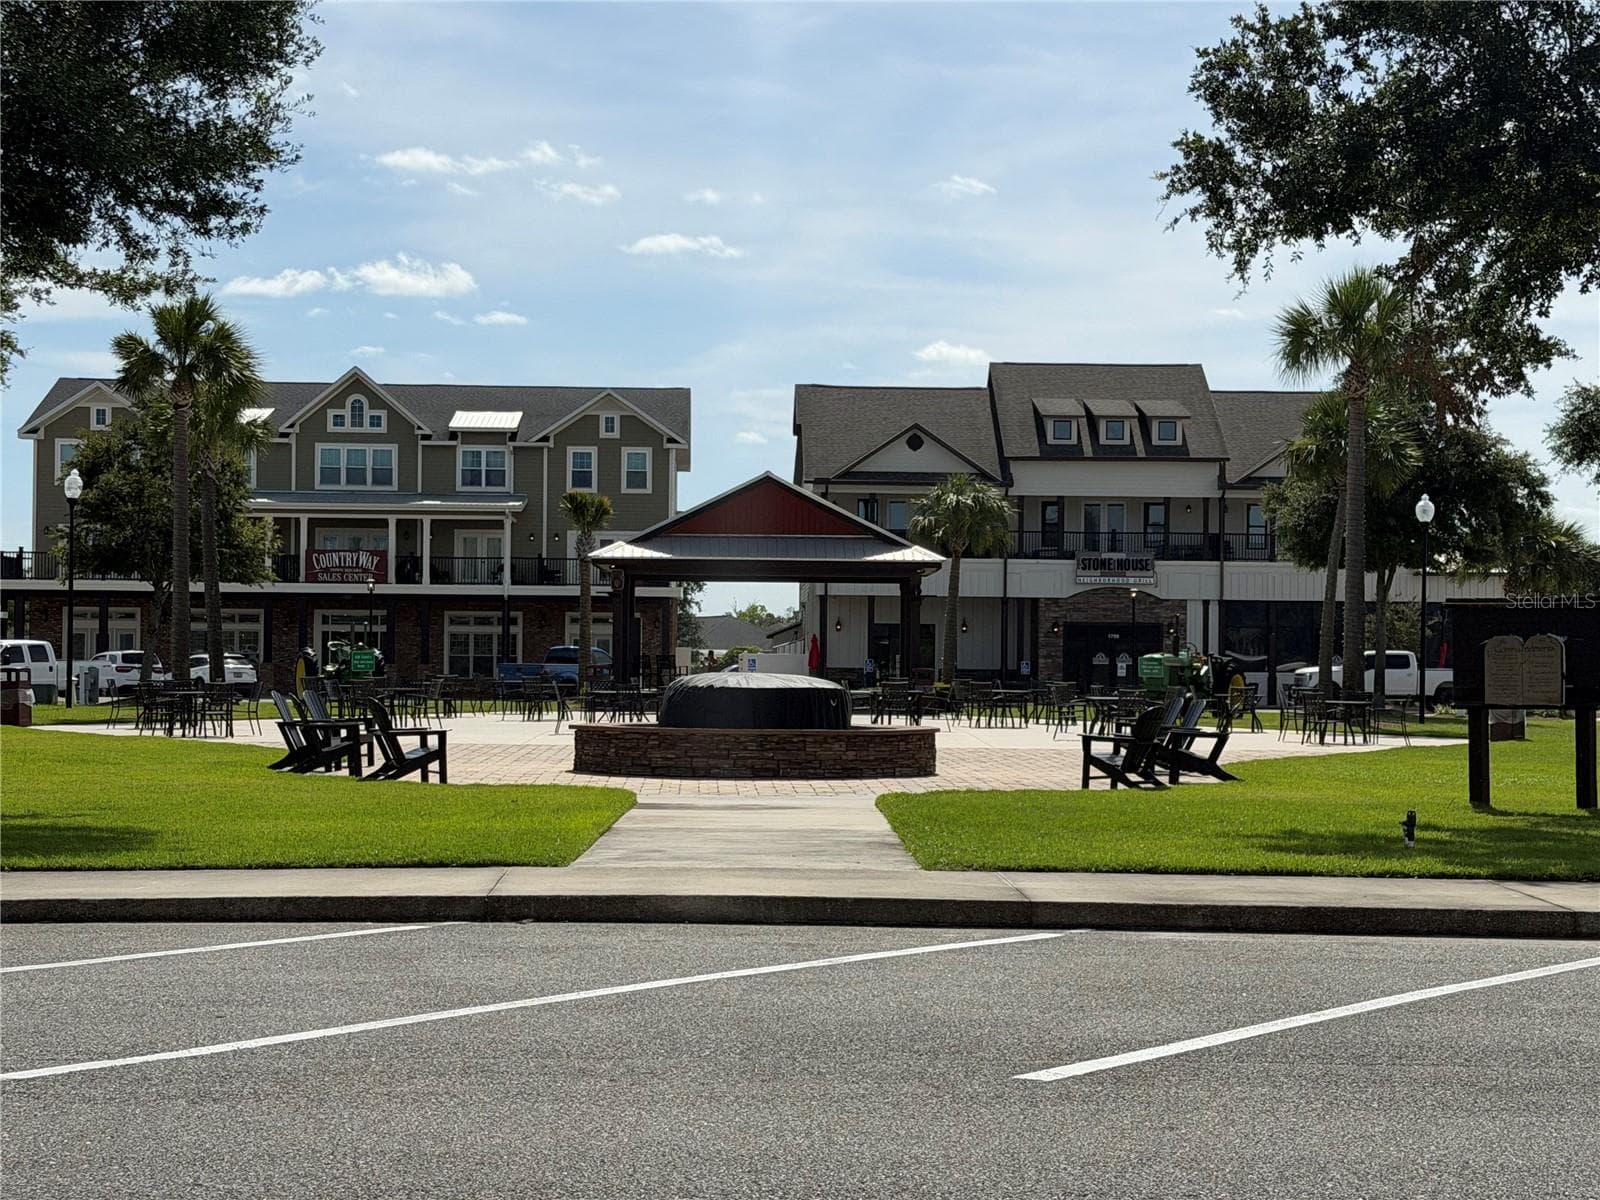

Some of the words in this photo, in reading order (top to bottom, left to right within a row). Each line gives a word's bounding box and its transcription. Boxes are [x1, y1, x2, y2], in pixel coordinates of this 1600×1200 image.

[1080, 557, 1113, 571] STONE
[1116, 558, 1152, 572] HOUSE
[317, 573, 341, 582] SALES
[343, 573, 374, 582] CENTER
